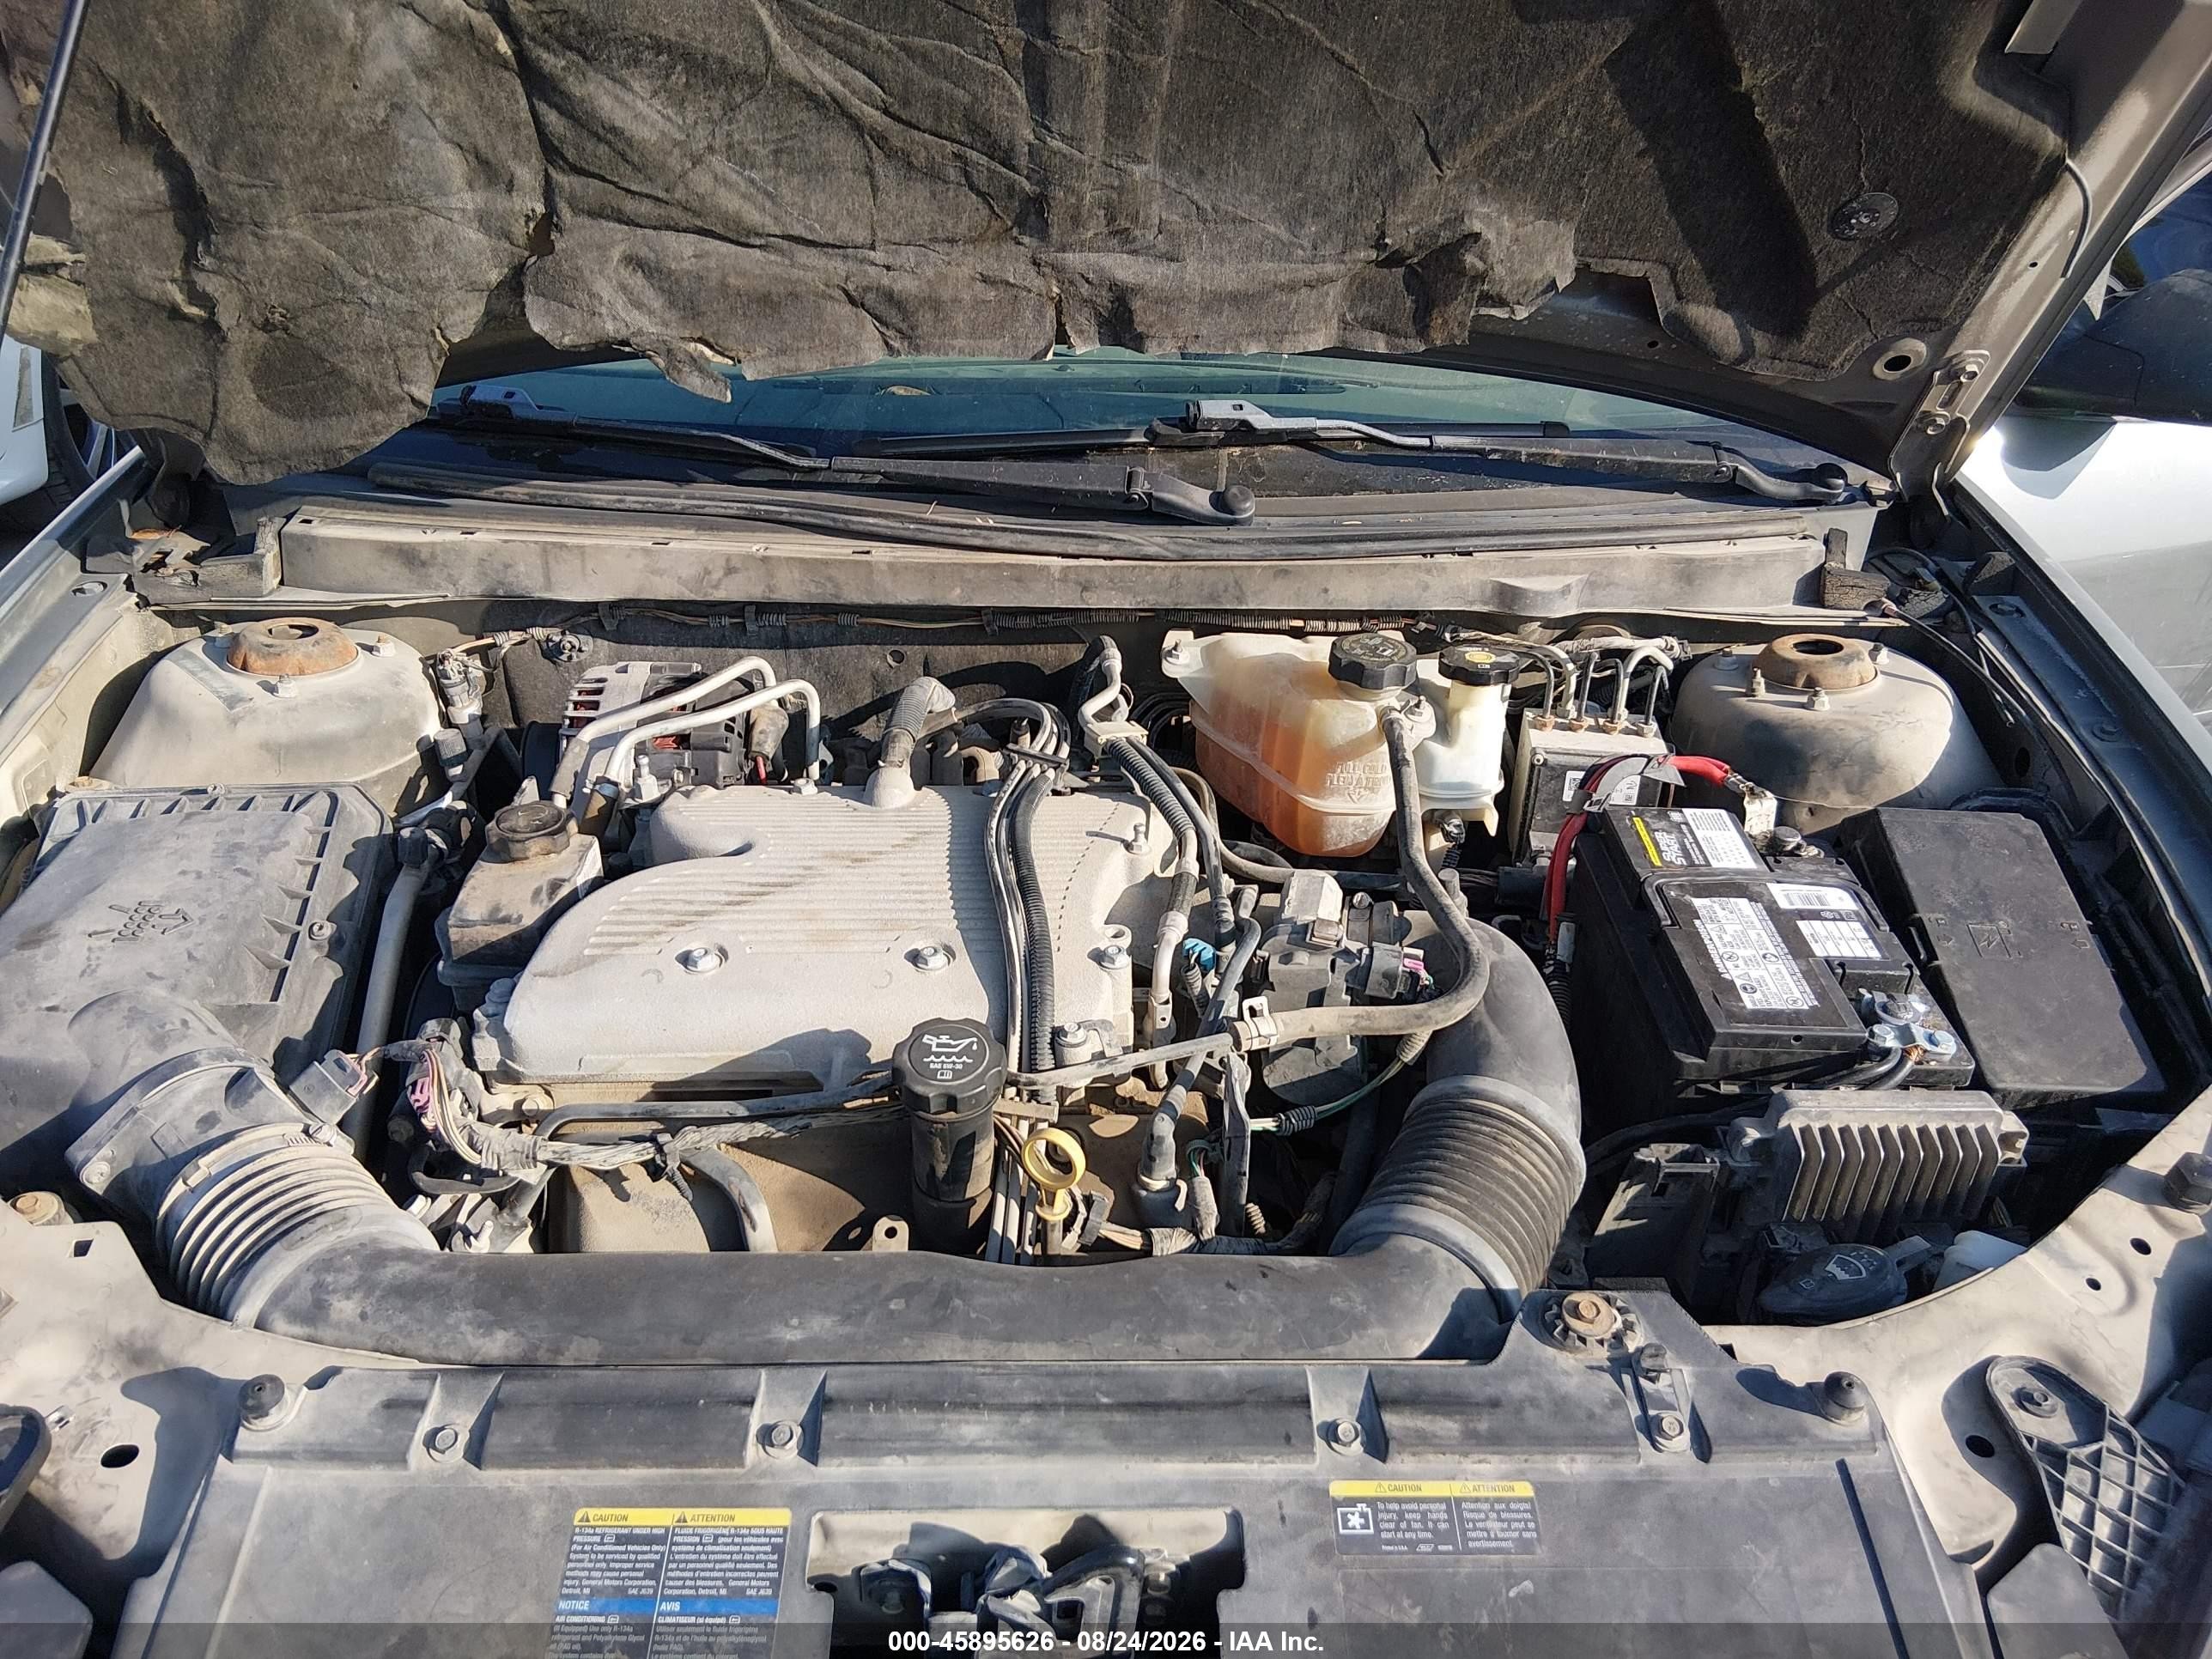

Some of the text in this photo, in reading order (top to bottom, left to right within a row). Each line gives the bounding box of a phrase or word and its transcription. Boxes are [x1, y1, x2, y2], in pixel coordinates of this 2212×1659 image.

[1386, 1502, 1399, 1510] help
[1419, 1502, 1446, 1511] personal
[593, 1514, 628, 1522] CAUTION
[690, 1514, 735, 1522] ATTENTION
[1378, 1511, 1398, 1520] injury,
[558, 1600, 590, 1609] NOTICE
[660, 1602, 680, 1611] AVIS
